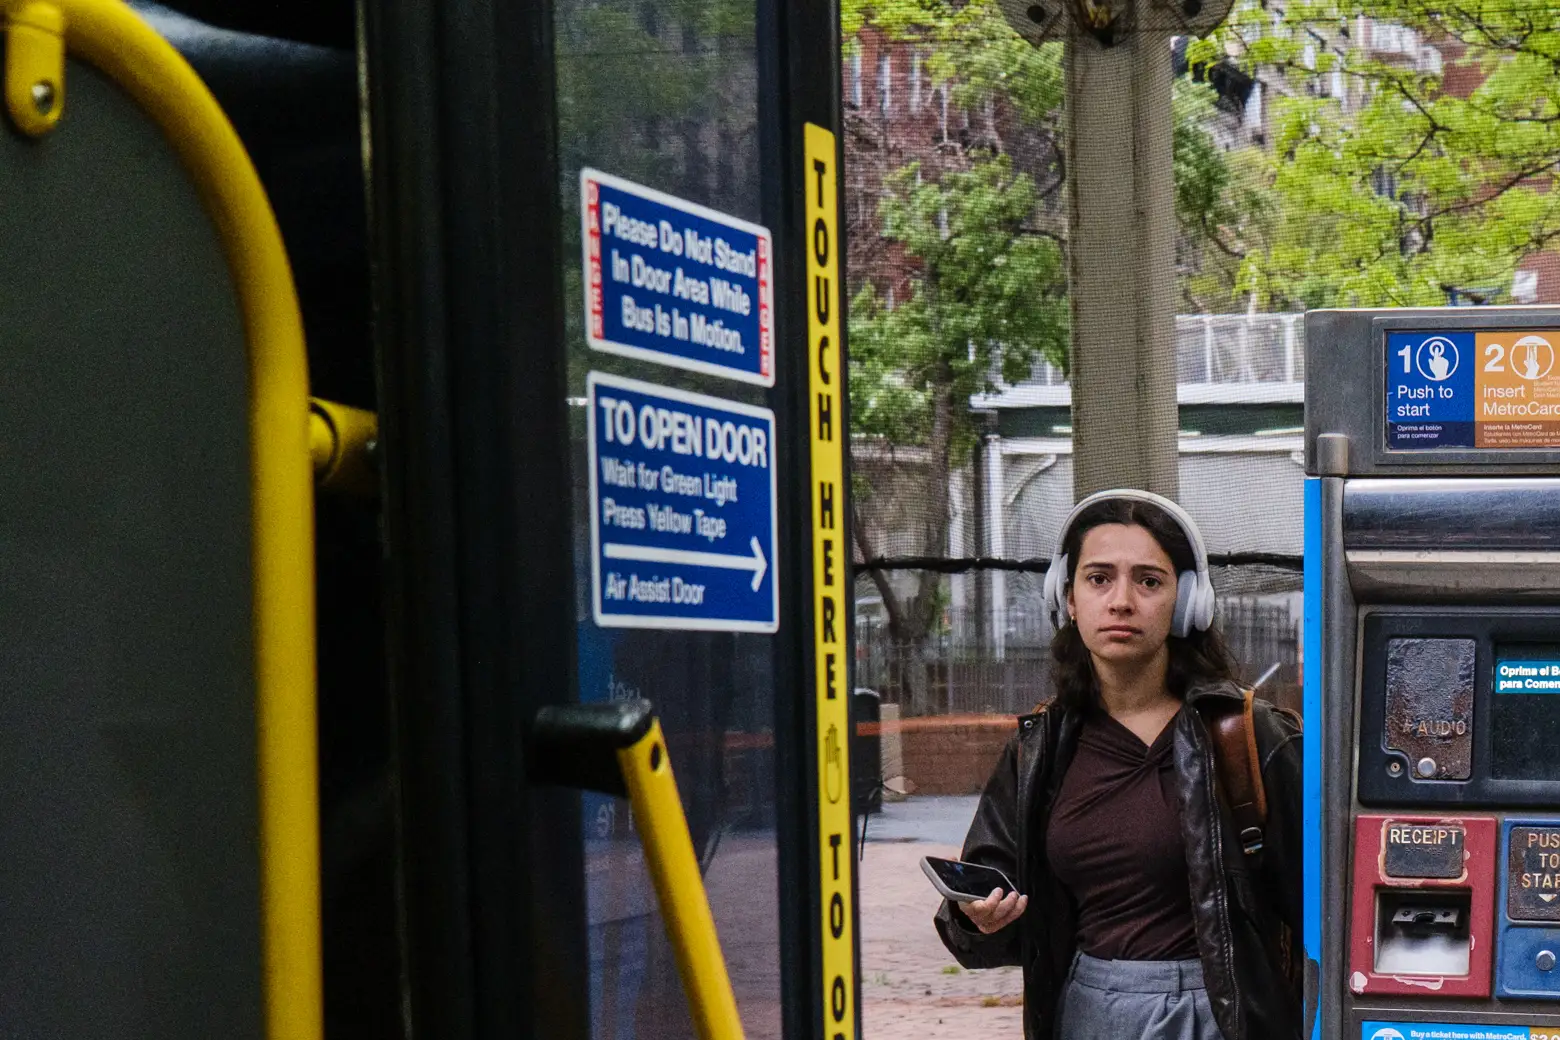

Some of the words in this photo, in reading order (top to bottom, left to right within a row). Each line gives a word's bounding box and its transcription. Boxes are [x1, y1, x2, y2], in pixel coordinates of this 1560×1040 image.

[602, 201, 658, 249] Please
[659, 220, 683, 256] Do
[684, 228, 713, 266] Not
[714, 237, 757, 278] Stand
[611, 249, 629, 283] In
[631, 253, 672, 295] Door
[673, 266, 710, 305] Area
[710, 277, 751, 316] While
[813, 158, 833, 442] TOUCH
[621, 294, 654, 334] Bus
[655, 303, 672, 337] Is
[672, 308, 689, 341] In
[690, 312, 745, 354] Motion.
[1397, 344, 1411, 373] 1
[1484, 344, 1505, 373] 2
[1397, 385, 1435, 399] Push
[1438, 386, 1454, 399] to
[1397, 403, 1430, 417] start
[600, 397, 636, 446] TO
[638, 405, 703, 457] OPEN
[705, 418, 768, 469] DOOR
[601, 457, 636, 488] Wait
[637, 461, 659, 491] for
[661, 466, 702, 497] Green
[704, 472, 739, 508] Light
[603, 498, 645, 530] Press
[647, 503, 693, 535] Yellow
[694, 509, 727, 543] Tape
[605, 572, 625, 600] Air
[629, 573, 671, 602] Assist
[672, 577, 706, 606] Door
[819, 481, 837, 700] HERE
[1499, 666, 1538, 679] Oprima
[1540, 666, 1550, 677] el
[1499, 680, 1523, 691] para
[1389, 828, 1460, 846] RECEIPT
[1539, 853, 1559, 868] TO
[828, 834, 843, 940] TO
[1410, 1030, 1426, 1040] Buy
[1431, 1031, 1453, 1039] ticket
[1454, 1032, 1472, 1040] here
[1473, 1032, 1485, 1040] with
